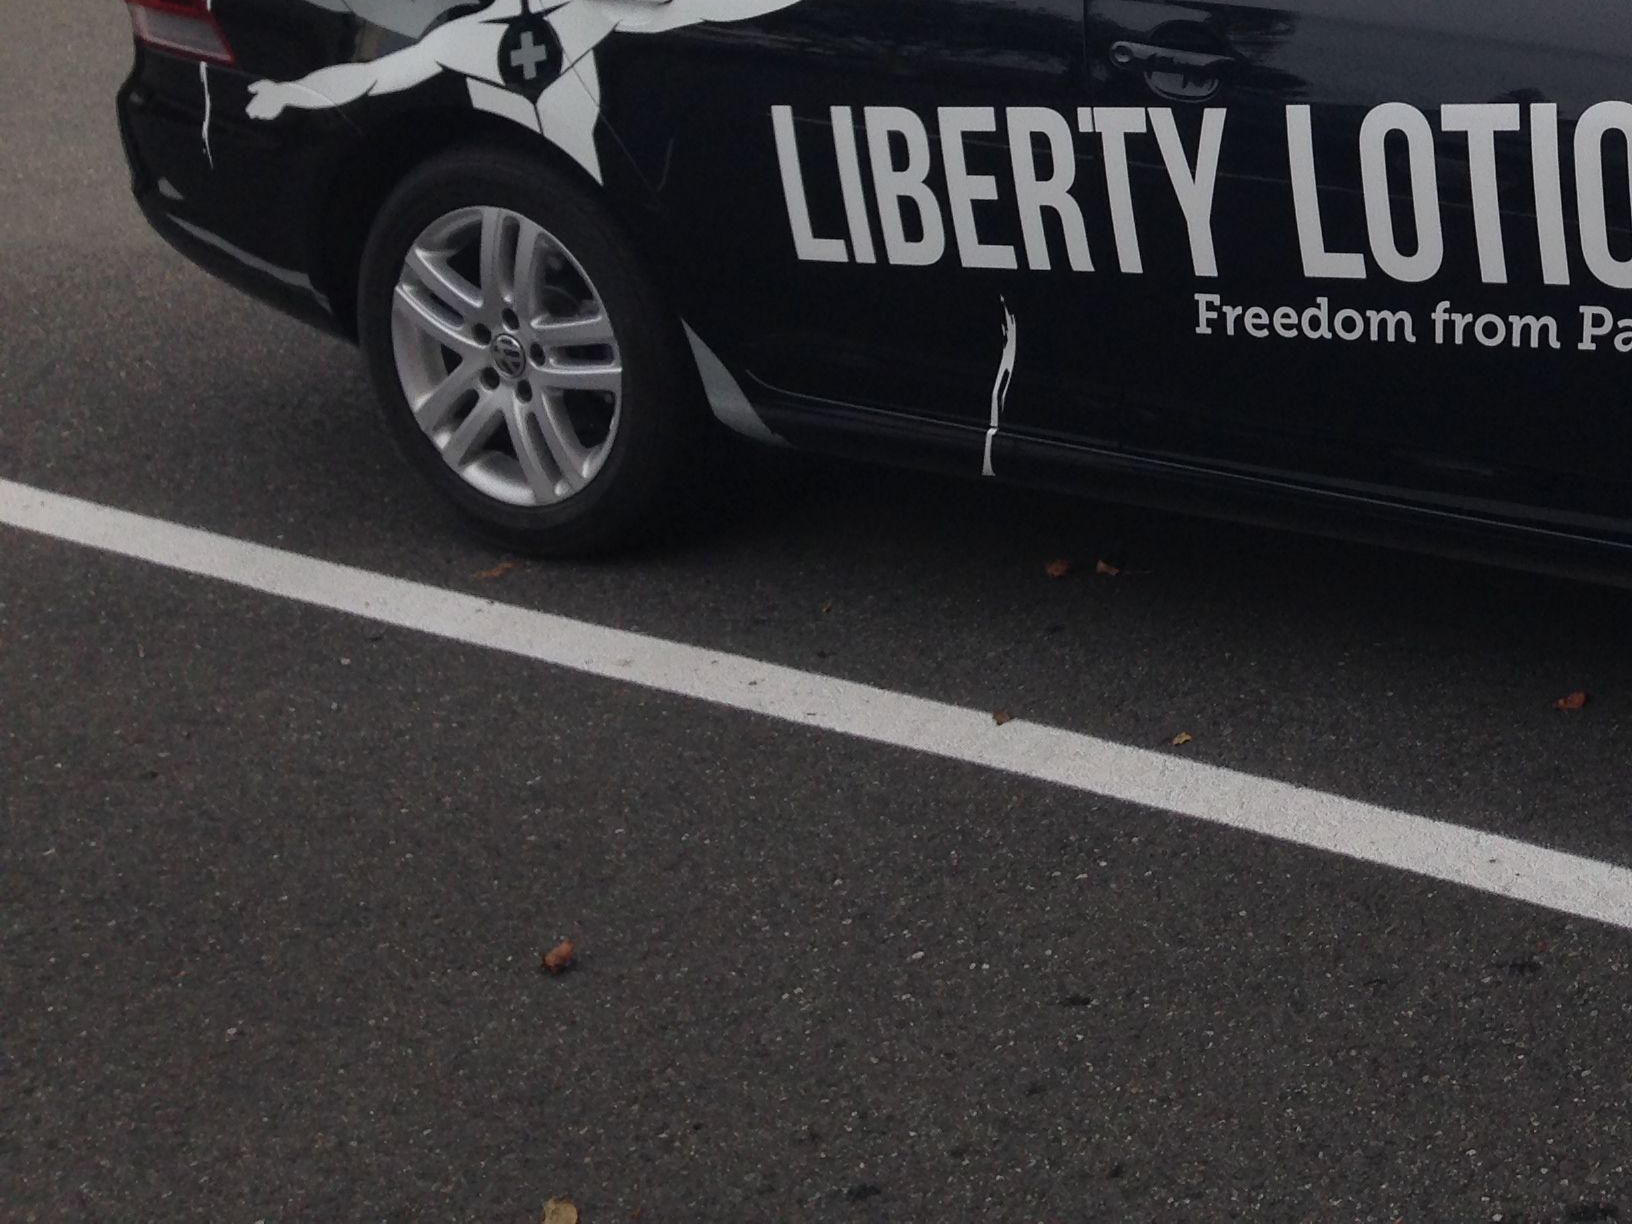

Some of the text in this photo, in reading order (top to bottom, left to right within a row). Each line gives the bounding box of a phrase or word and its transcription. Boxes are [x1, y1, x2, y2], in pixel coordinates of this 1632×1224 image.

[771, 105, 1227, 277] LIBERTY
[1195, 293, 1416, 343] Freedom
[1431, 300, 1561, 349] from
